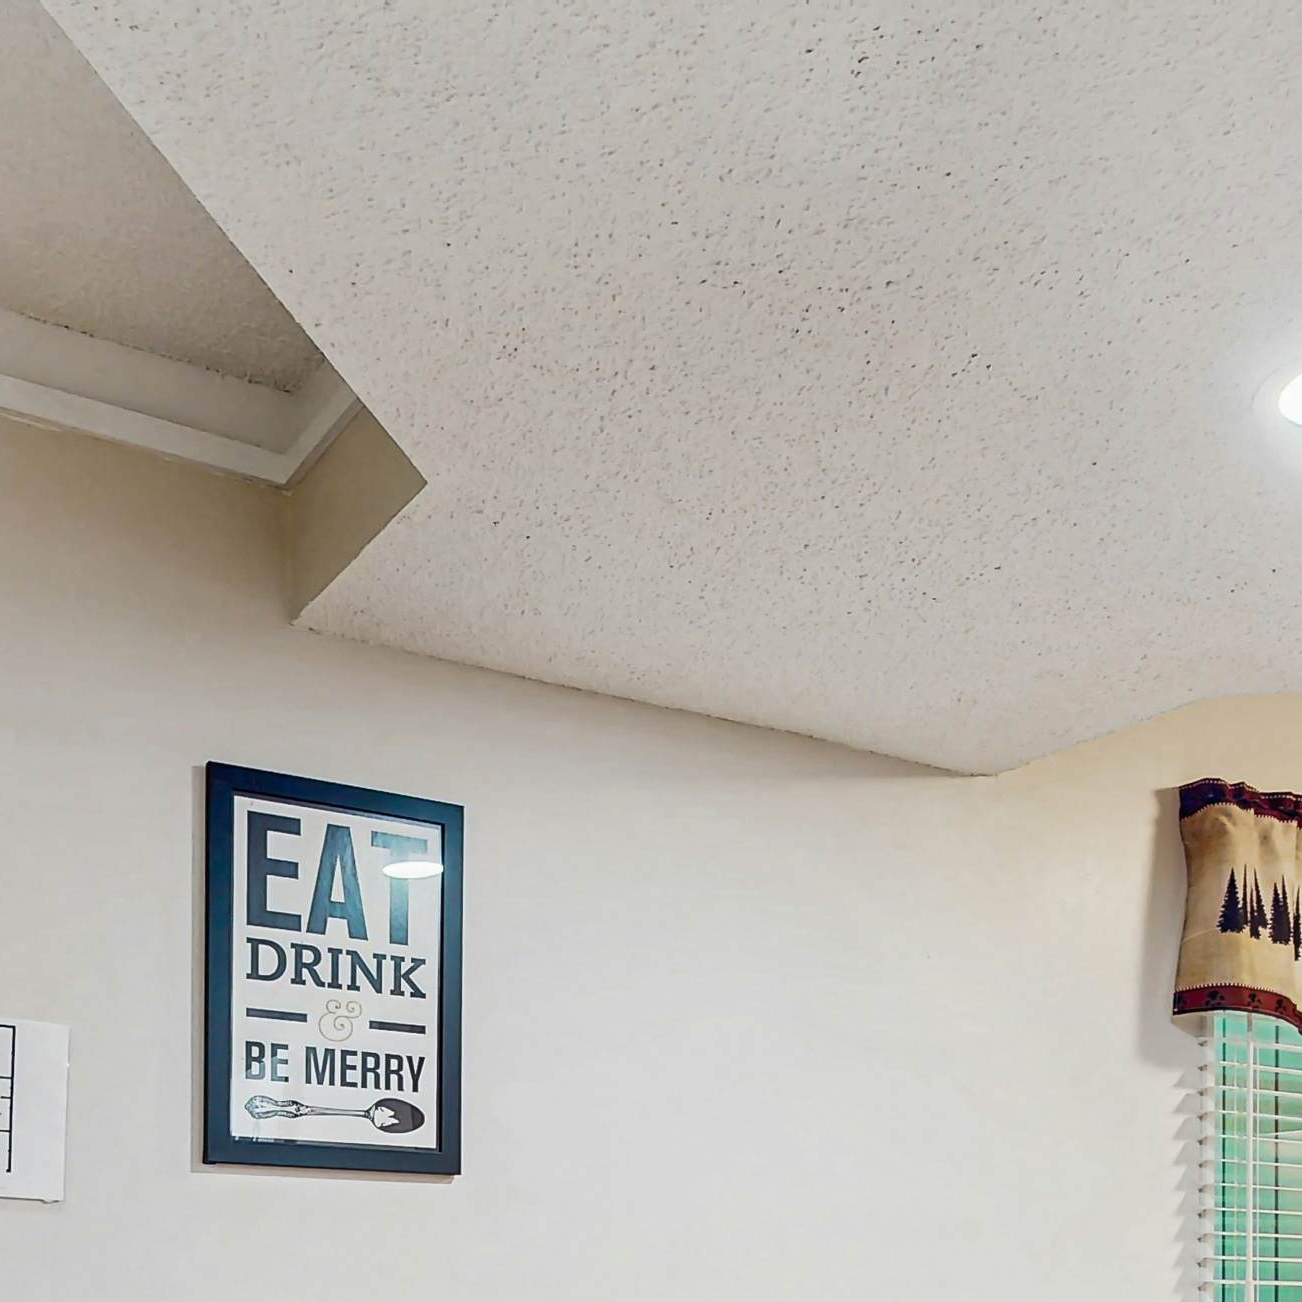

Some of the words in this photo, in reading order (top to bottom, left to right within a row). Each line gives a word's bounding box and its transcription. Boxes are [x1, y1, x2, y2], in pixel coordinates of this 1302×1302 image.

[246, 810, 428, 946] EAT
[246, 937, 426, 999] DRINK
[318, 999, 363, 1042] &
[244, 1040, 290, 1083] BE
[305, 1045, 426, 1093] MERRY
